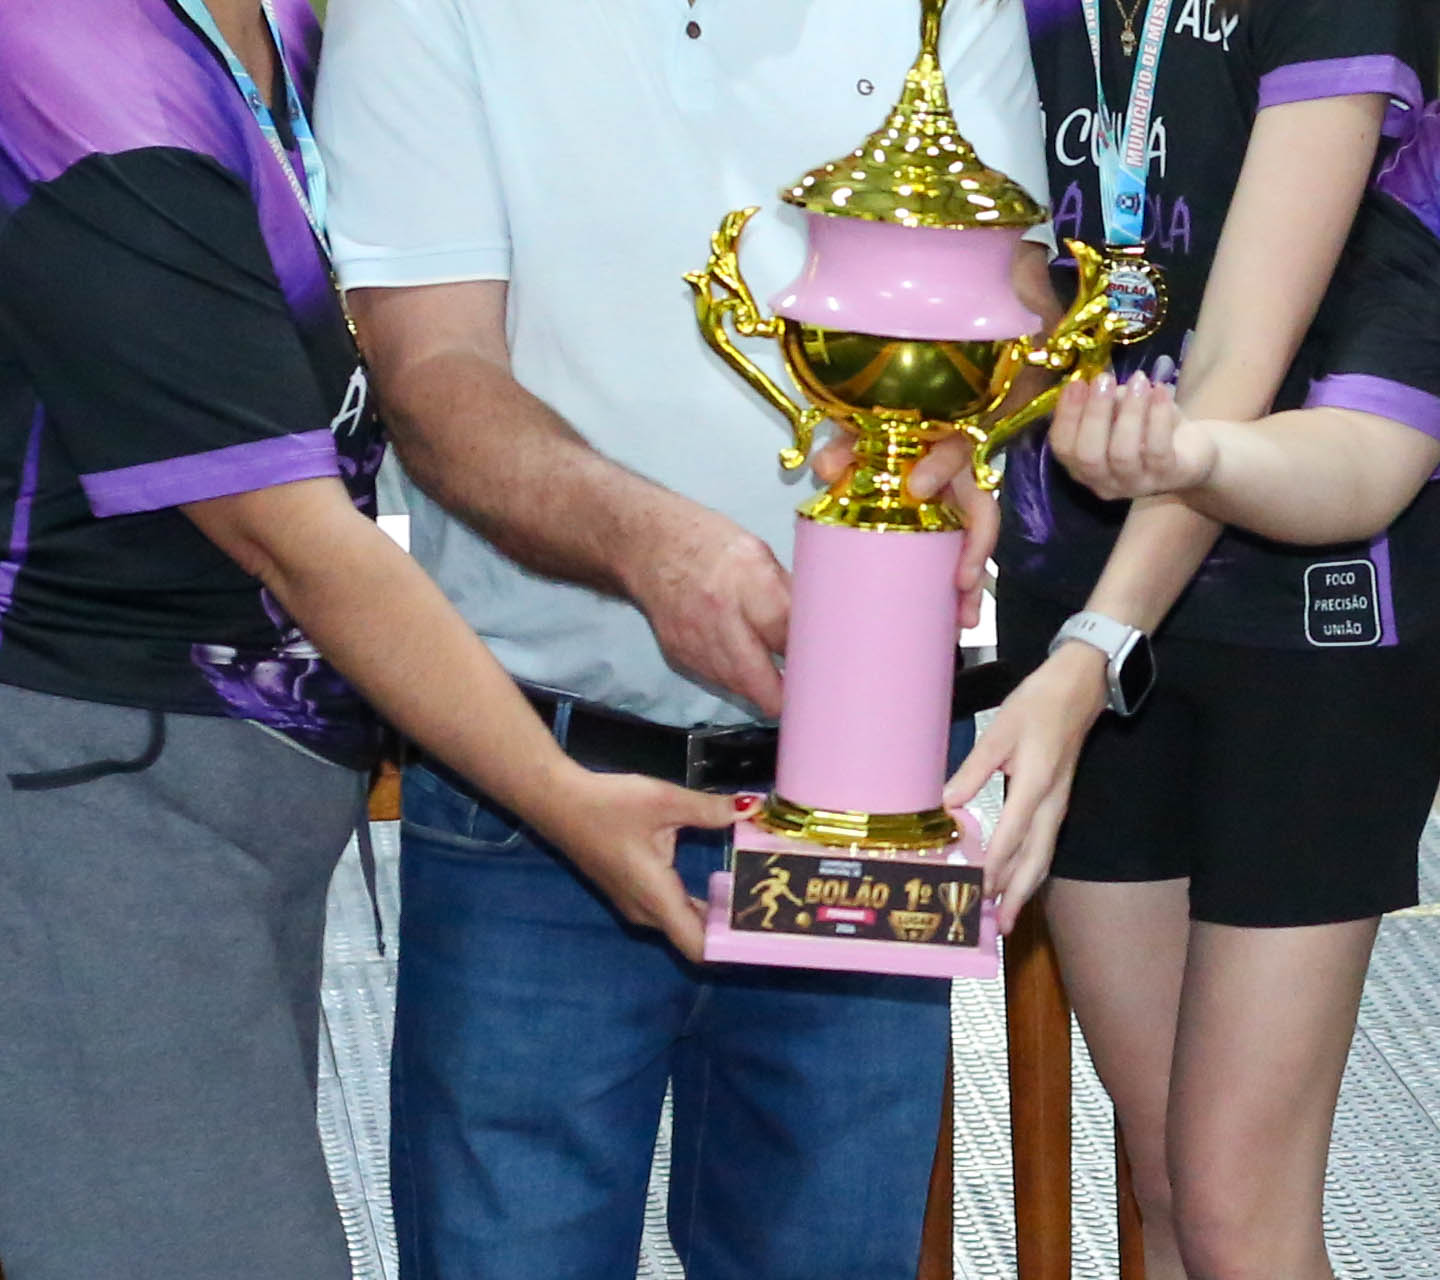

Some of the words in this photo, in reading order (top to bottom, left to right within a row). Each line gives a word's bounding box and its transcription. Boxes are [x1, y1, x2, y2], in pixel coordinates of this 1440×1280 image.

[1325, 572, 1356, 587] FOCO
[1314, 594, 1368, 612] PRECISÃO
[1323, 619, 1363, 636] UNIÃO
[804, 876, 890, 909] BOLÃO
